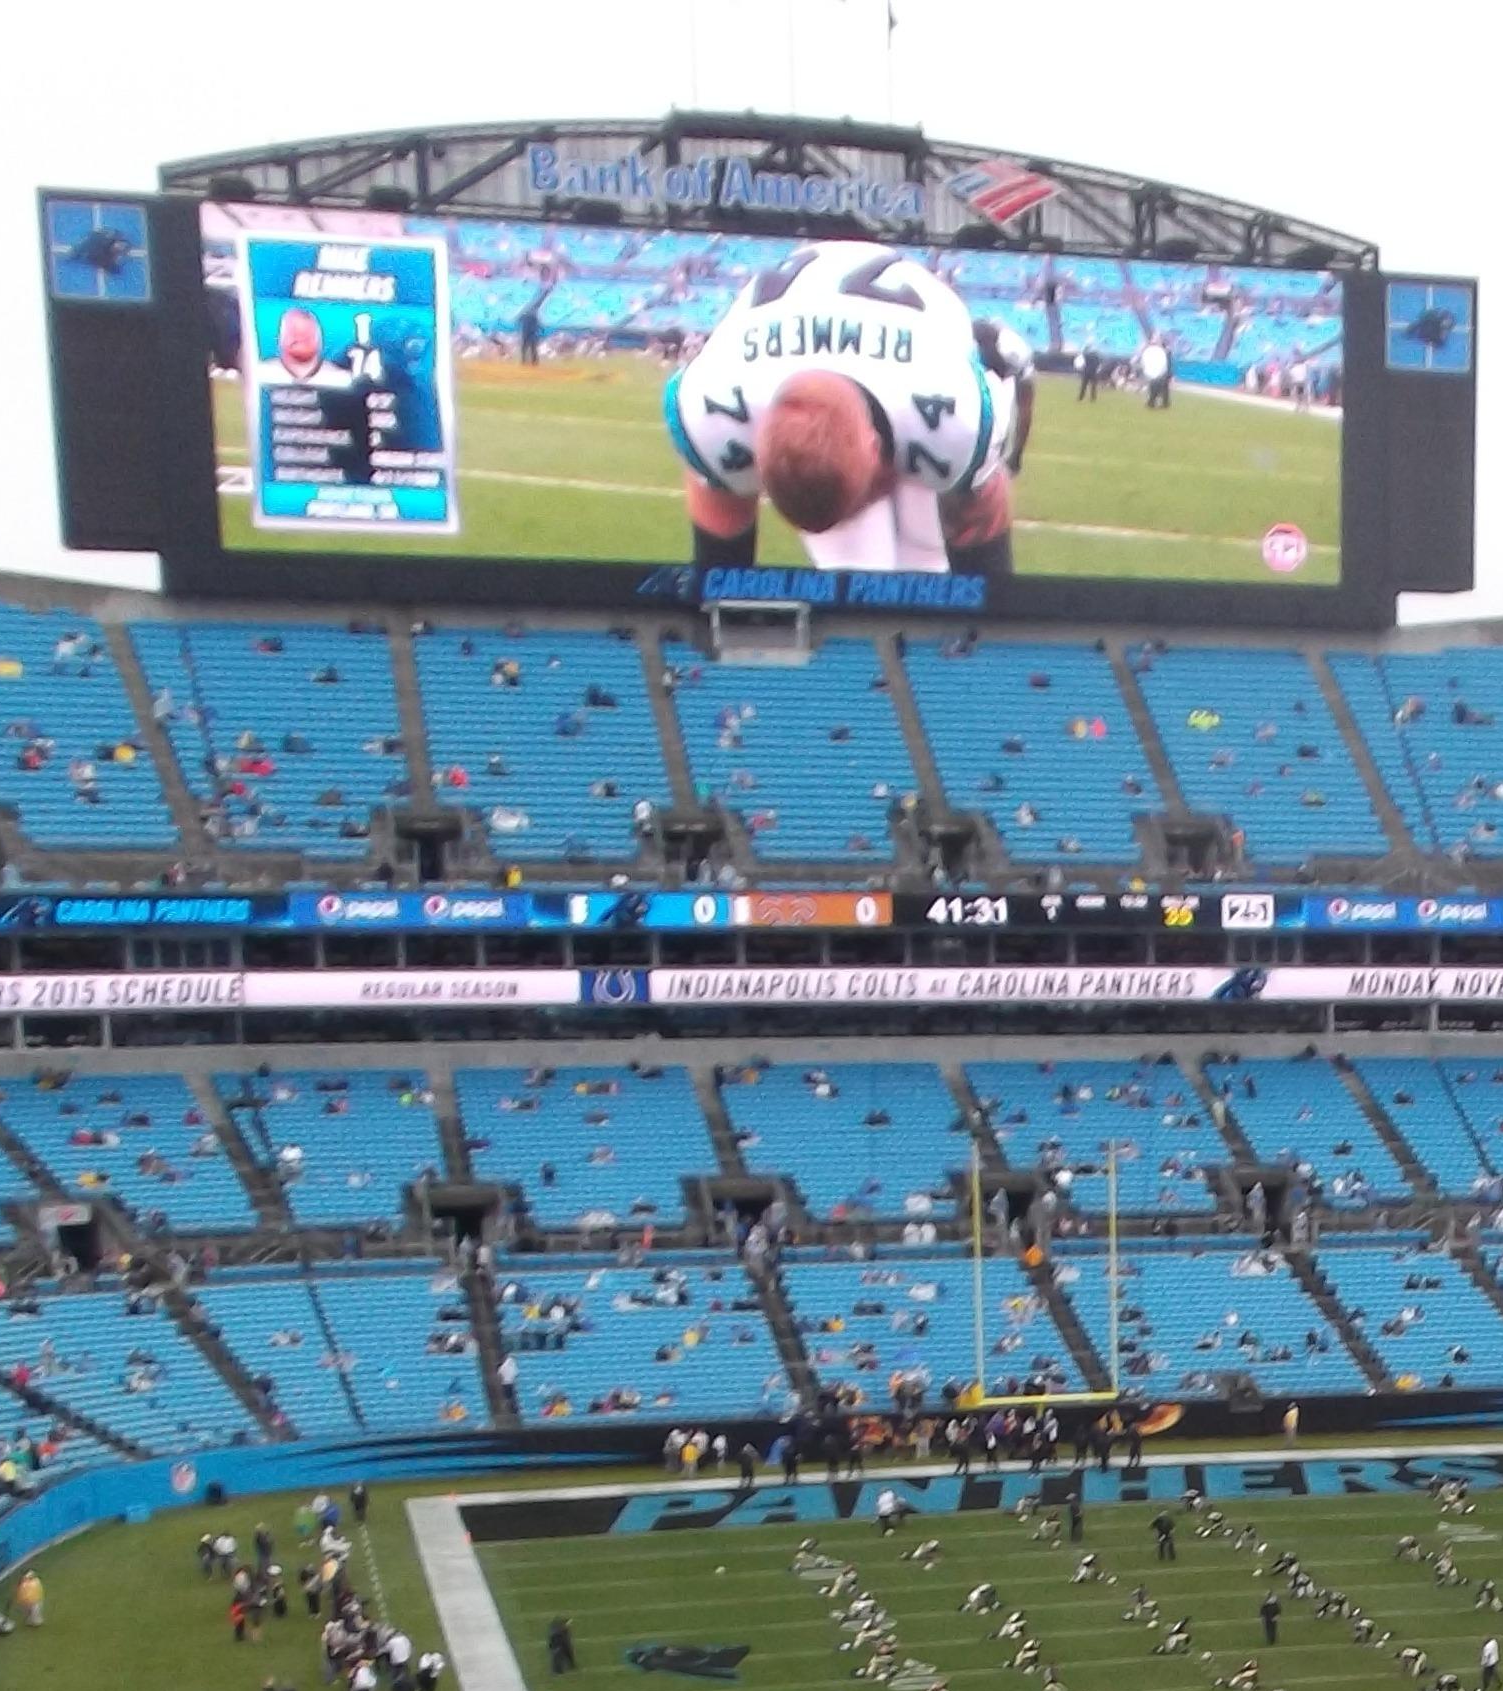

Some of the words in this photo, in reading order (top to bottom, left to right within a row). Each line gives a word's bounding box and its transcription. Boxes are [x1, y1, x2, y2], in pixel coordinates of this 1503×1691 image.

[528, 142, 654, 197] Bank
[663, 158, 714, 202] of
[721, 159, 925, 219] America
[743, 314, 913, 363] REMMERS
[704, 567, 838, 601] CAROLINA
[850, 571, 986, 606] PANTHERS
[54, 899, 150, 925] CAROLINA
[153, 899, 251, 924] PANTHERS
[693, 895, 716, 925] 0
[855, 895, 876, 924] 0
[925, 897, 1009, 924] 41:31
[31, 979, 97, 1007] 2015
[106, 976, 244, 1006] SCHEDULE
[360, 981, 443, 999] REGULAR
[449, 980, 519, 999] SEASON
[667, 972, 835, 999] INDIANAPOLIS
[847, 972, 917, 997] COLTS
[955, 971, 1071, 997] CAROLINA
[1077, 971, 1195, 997] PANTHERS
